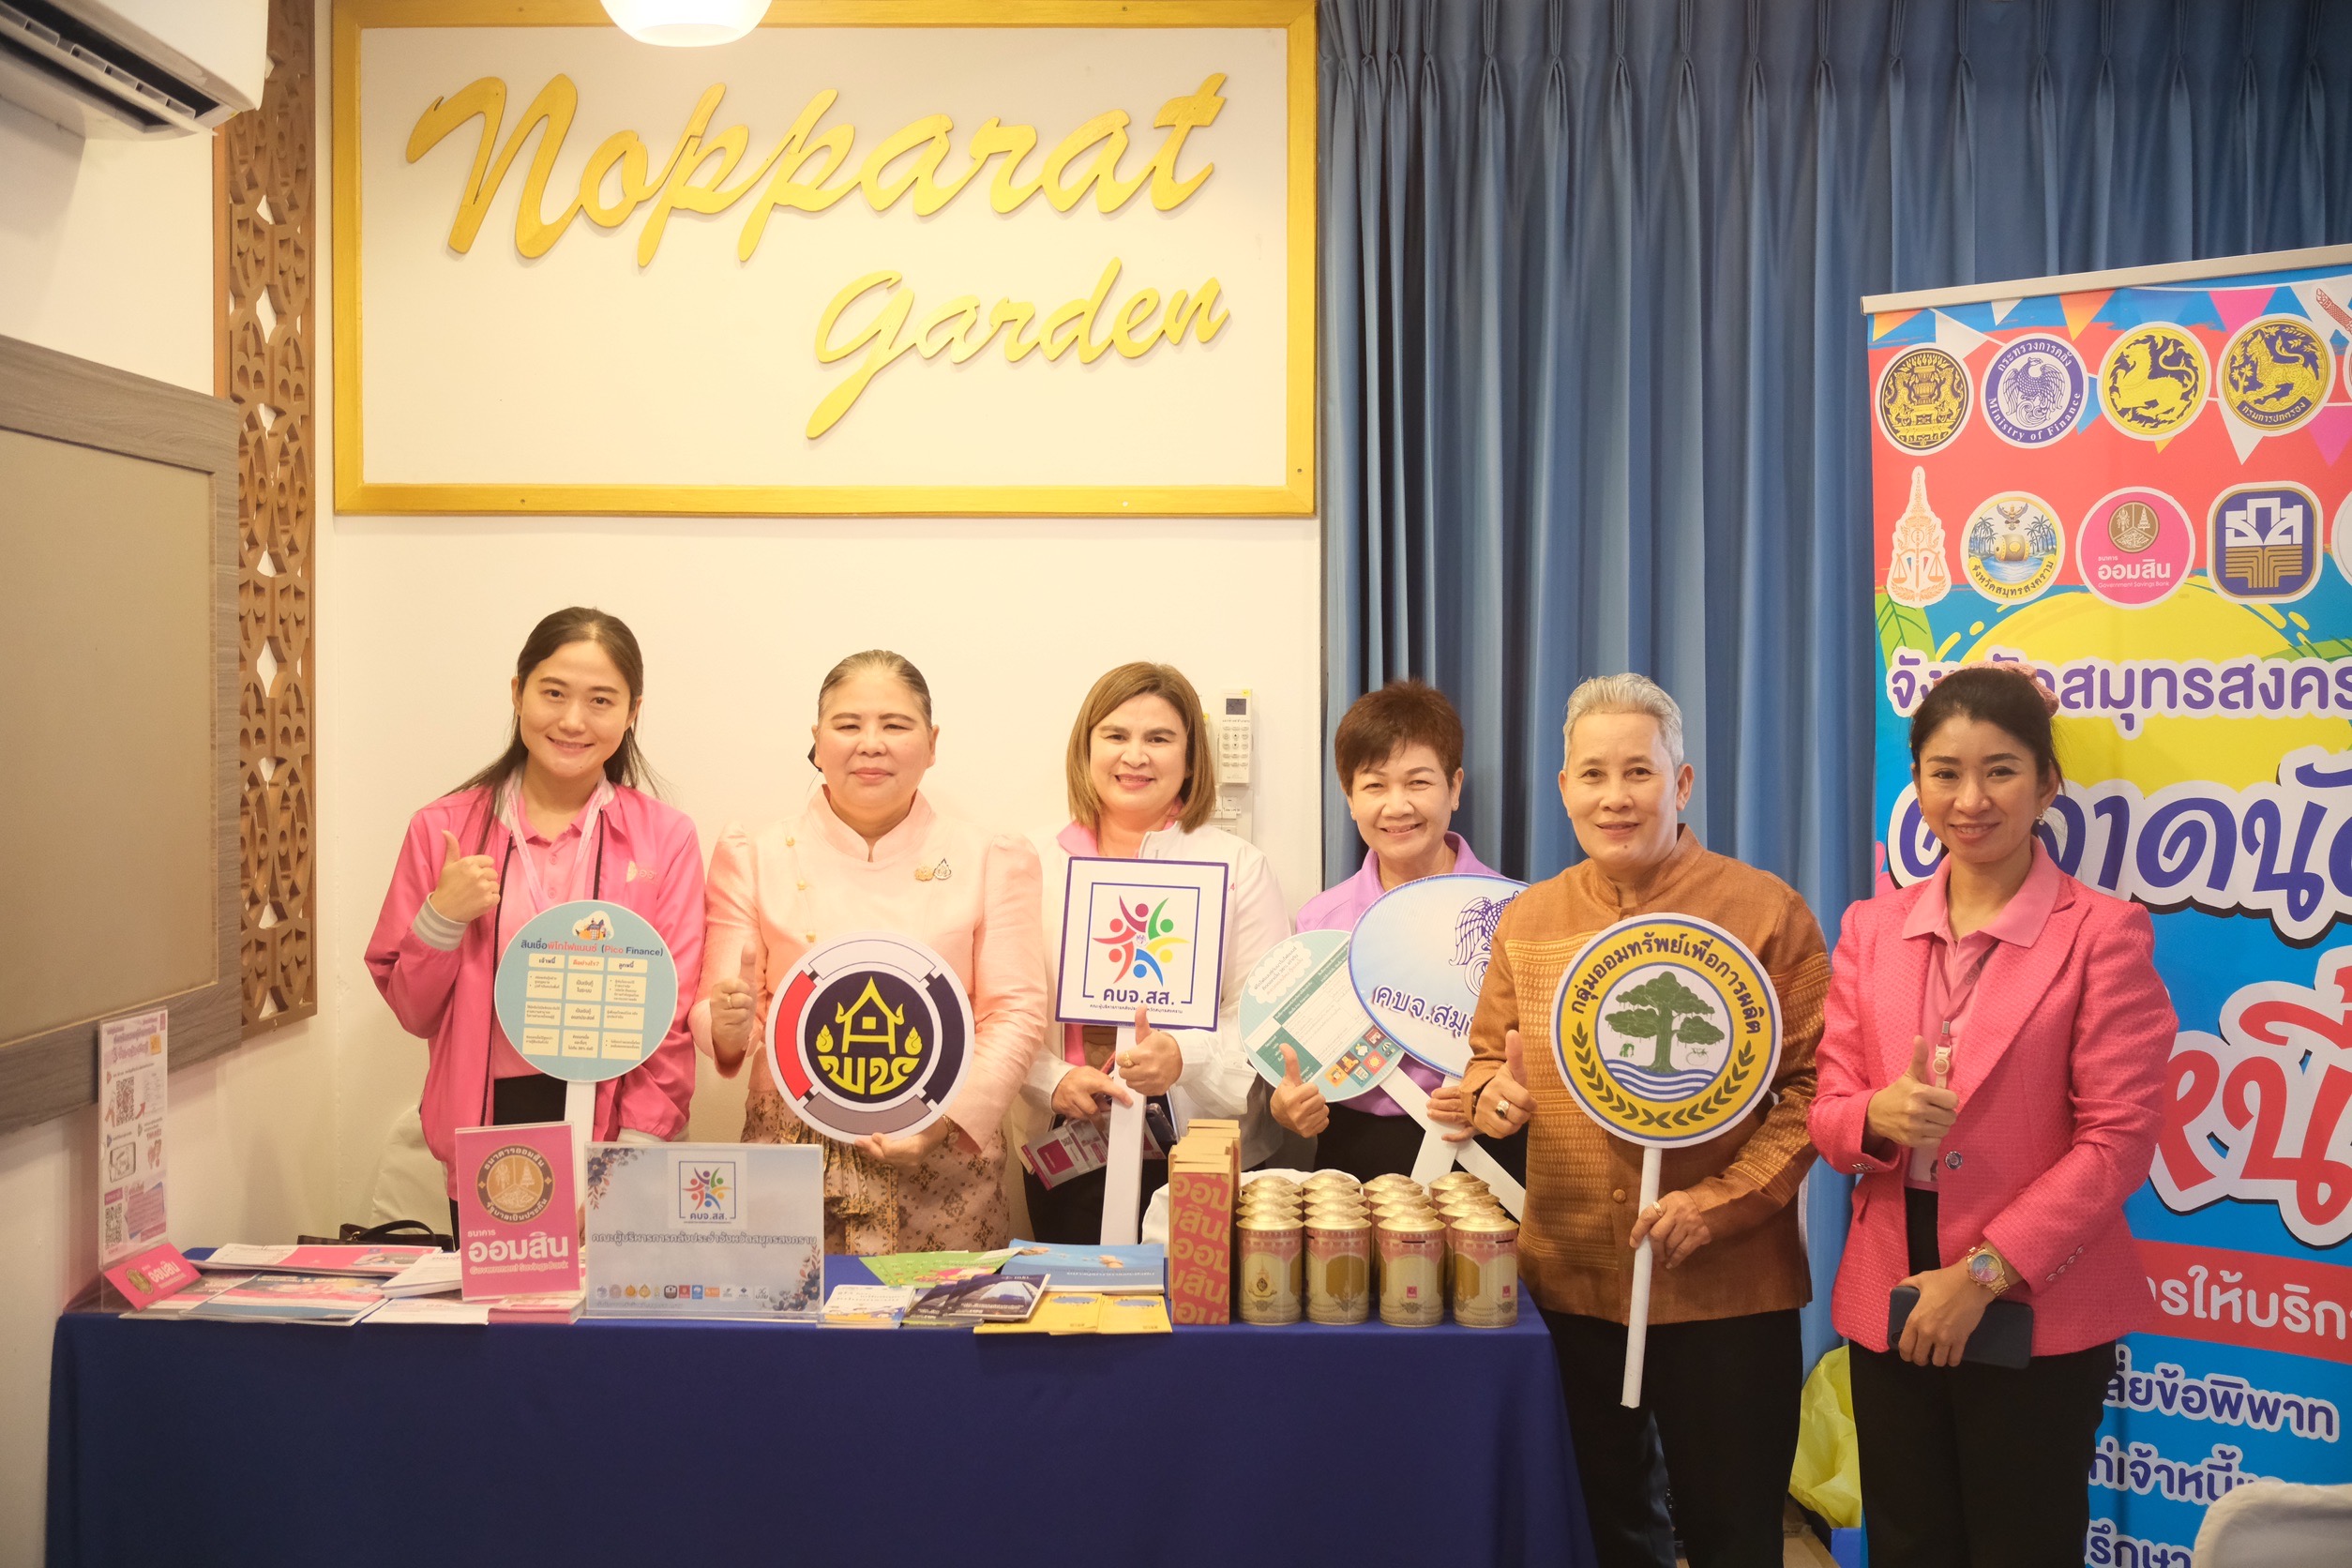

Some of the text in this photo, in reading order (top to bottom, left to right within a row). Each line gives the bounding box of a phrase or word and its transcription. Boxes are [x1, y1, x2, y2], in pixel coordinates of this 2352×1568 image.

[1998, 341, 2073, 372] กระทรวงการคลัง
[1988, 393, 2081, 442] Ministry of Finance
[1971, 560, 2055, 598] จังหวัดสมุทรสงคราม
[2098, 559, 2171, 580] ออมสิน
[2133, 580, 2155, 589] Savings
[601, 943, 624, 955] (Pico
[626, 946, 664, 957] Finance)
[1103, 988, 1175, 1005] คบจ.สส.
[1571, 931, 1765, 1034] กลุ่มออมทรัพย์เพื่อการผลิต
[484, 1147, 546, 1170] ธนาคารออมสิน
[467, 1229, 496, 1238] ธนาคาร
[468, 1231, 569, 1263] ออมสิน
[470, 1264, 519, 1275] Government
[2147, 1264, 2352, 1340] รให้บริก
[2090, 1441, 2254, 1502] ก่เจ้าหนี้
[2083, 1523, 2192, 1568] รึกษา
